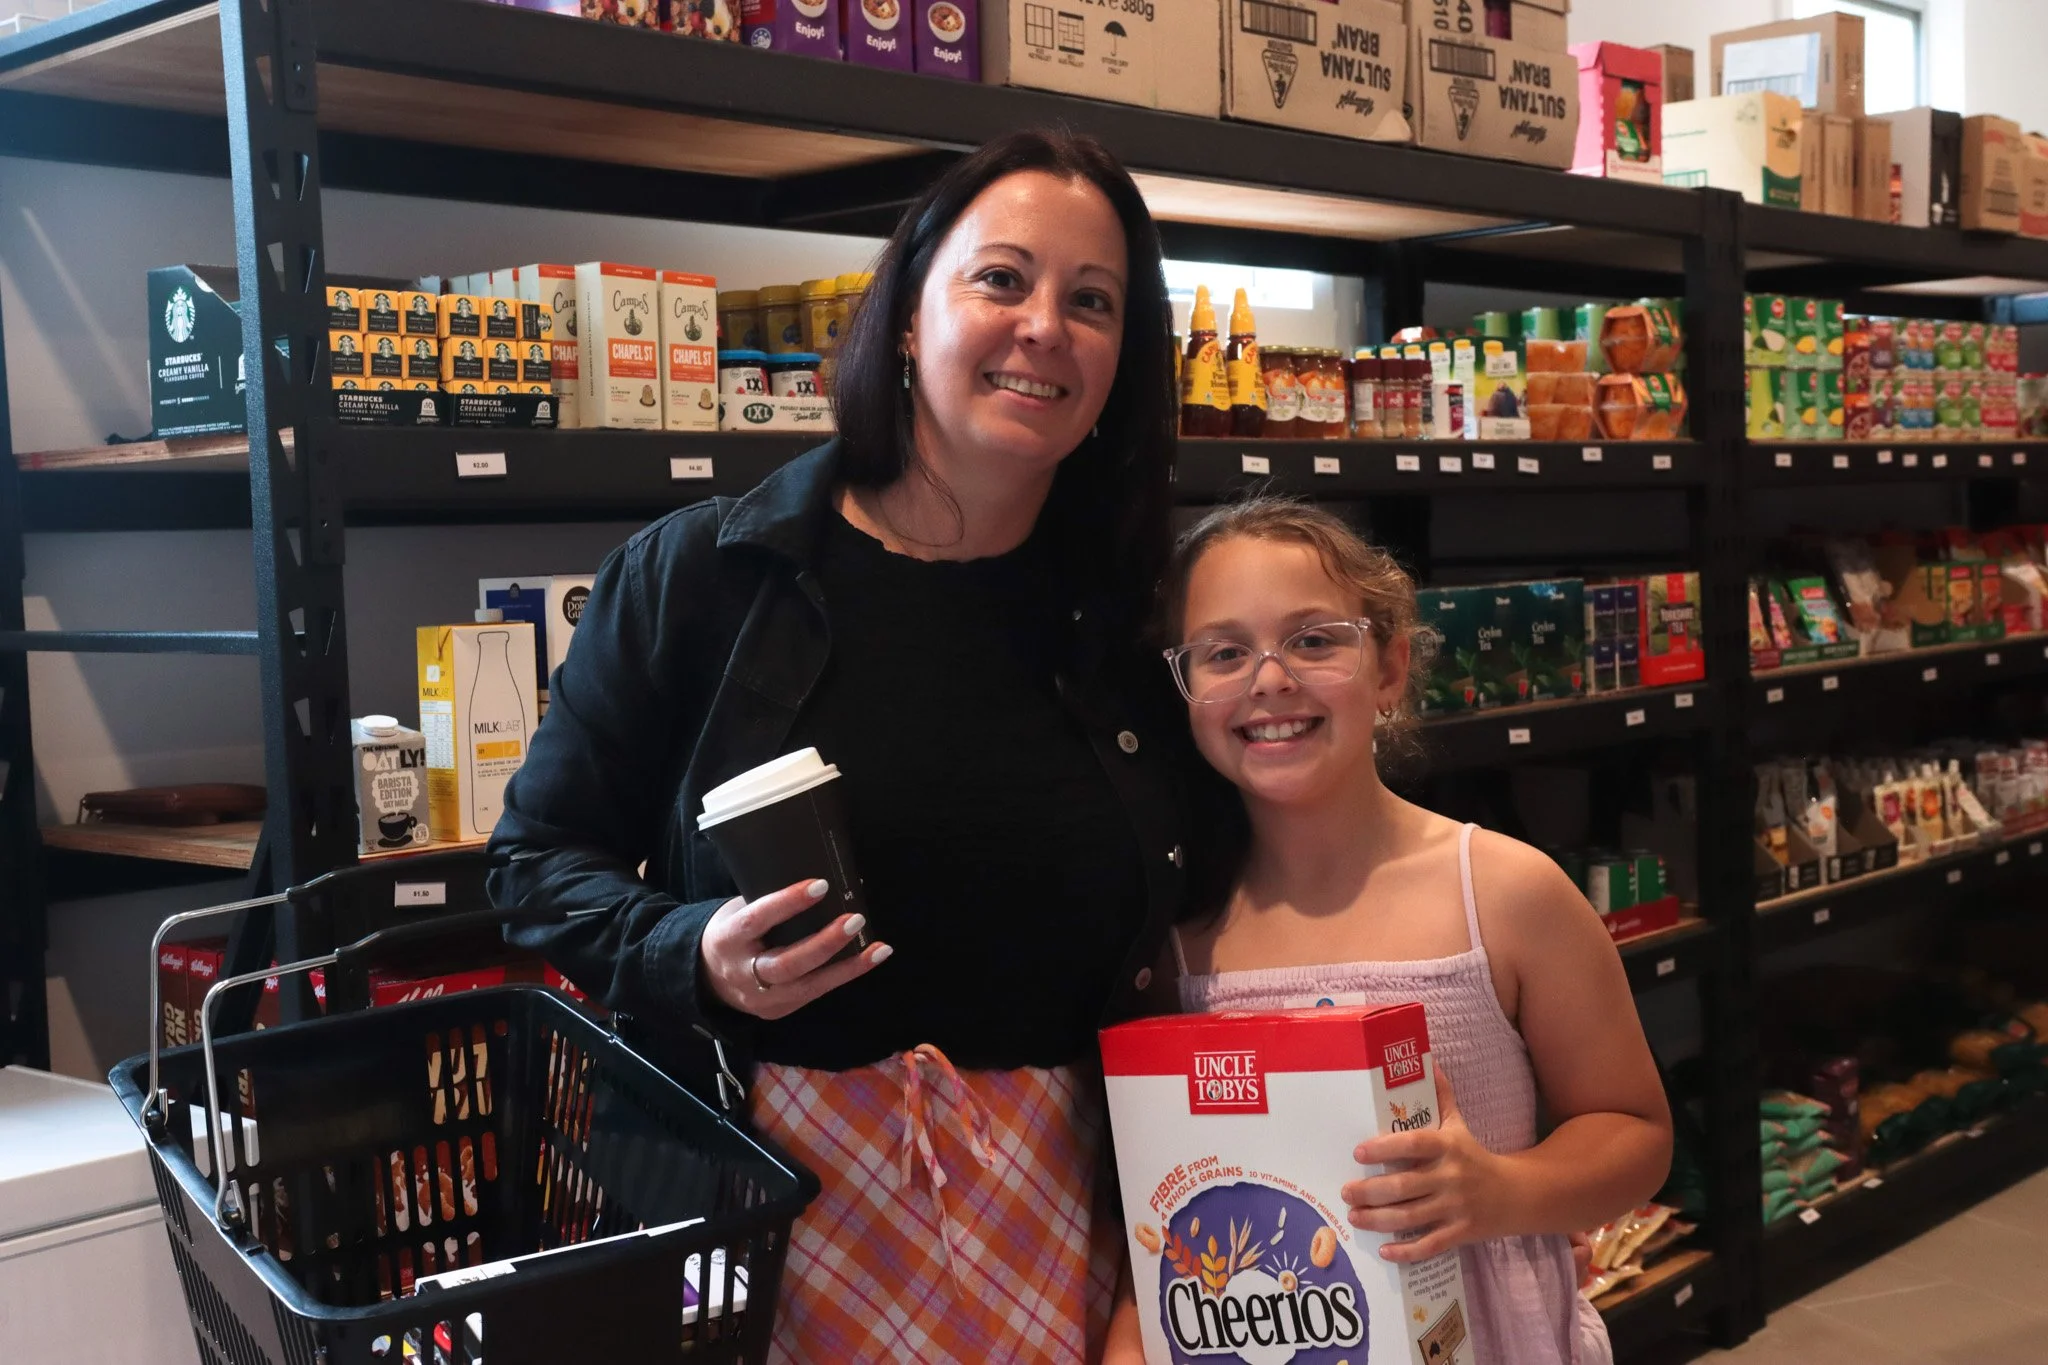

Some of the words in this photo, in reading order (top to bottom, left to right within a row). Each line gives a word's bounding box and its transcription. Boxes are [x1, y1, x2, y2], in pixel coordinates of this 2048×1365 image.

[1121, 0, 1154, 22] 380g
[795, 22, 825, 38] Enjoy!
[866, 34, 896, 52] Enjoy!
[1336, 23, 1380, 57] BRAN
[933, 46, 962, 62] Enjoy!
[1320, 51, 1391, 92] SULTANA
[1513, 59, 1551, 89] BRAN
[1498, 85, 1566, 120] SULTANA
[164, 353, 202, 366] STARBUCKS
[552, 345, 578, 361] CHAP
[612, 343, 643, 361] CHAPEL
[643, 346, 653, 362] ST
[673, 348, 702, 365] CHAPEL
[702, 350, 712, 366] ST
[158, 367, 182, 378] CREAMY
[183, 363, 209, 375] VANILLA
[338, 394, 383, 403] STARBUCKS
[338, 401, 369, 409] CREAMY
[370, 402, 399, 411] VANILLA
[460, 398, 502, 406] STARBUCKS
[747, 405, 770, 420] IXL
[567, 600, 586, 611] Dolc
[474, 720, 520, 734] MILKLAB
[362, 748, 426, 772] OATLY!
[378, 776, 412, 789] BARISTA
[380, 787, 412, 800] EDITION
[383, 800, 394, 809] OAT
[394, 799, 409, 807] MILK
[161, 952, 183, 970] Kellogg's
[190, 958, 213, 976] Kellogg's
[1383, 1041, 1418, 1063] UNCLE
[1194, 1054, 1256, 1079] UNCLE
[1386, 1056, 1421, 1079] TOBYS
[1194, 1078, 1260, 1103] TOBYS
[1391, 1107, 1432, 1133] Cheerios
[1199, 1166, 1244, 1183] GRAINS
[1149, 1163, 1187, 1213] FIBRE
[1187, 1155, 1219, 1175] FROM
[1164, 1177, 1198, 1212] WHOLE
[1260, 1171, 1298, 1192] VITAMINS
[1299, 1189, 1317, 1204] AND
[1316, 1201, 1351, 1242] MINERALS
[1161, 1211, 1168, 1221] 4
[1168, 1281, 1359, 1351] Cheerios
